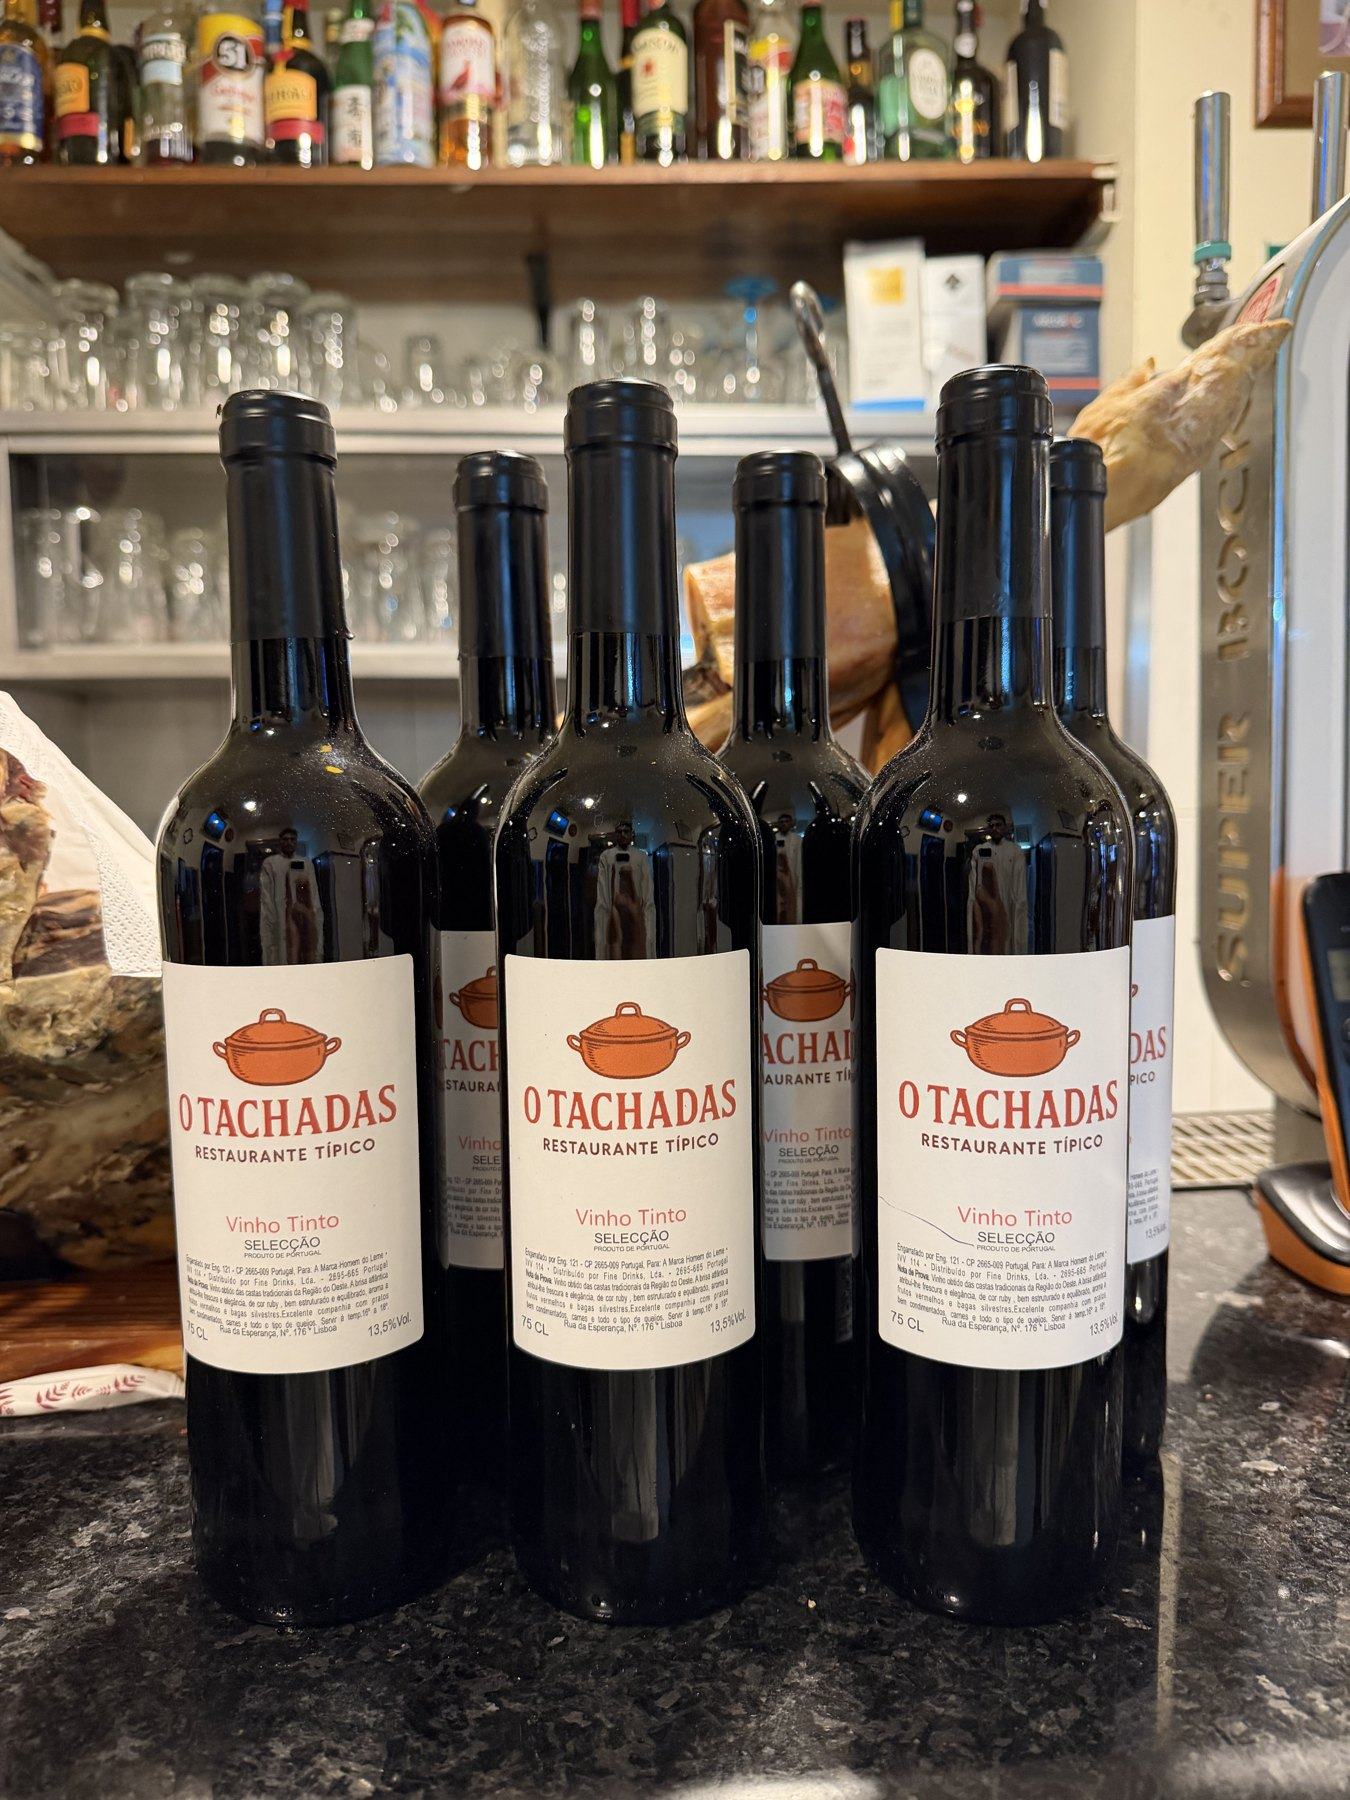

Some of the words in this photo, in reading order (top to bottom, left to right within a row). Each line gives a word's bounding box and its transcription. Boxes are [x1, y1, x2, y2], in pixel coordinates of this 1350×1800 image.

[1216, 711, 1252, 989] SUPER
[765, 1072, 831, 1085] AURANTE
[179, 1093, 193, 1131] O
[198, 1084, 397, 1138] TACHADAS
[524, 1085, 541, 1124] O
[547, 1079, 737, 1131] TACHADAS
[898, 1080, 919, 1119] O
[927, 1080, 1118, 1129] TACHADAS
[764, 1128, 809, 1142] Vinho
[815, 1127, 852, 1141] Tinto
[196, 1144, 307, 1163] RESTAURANTE
[315, 1138, 375, 1160] TÍPICO
[543, 1137, 658, 1155] RESTAURANTE
[666, 1132, 719, 1152] TÍPICO
[779, 1144, 839, 1158] SELECÇÃO
[921, 1133, 1046, 1155] RESTAURANTE
[1054, 1134, 1103, 1154] TÍPICO
[575, 1208, 631, 1227] Vinho
[638, 1208, 686, 1226] Tinto
[957, 1205, 1017, 1227] Vinho
[1024, 1209, 1072, 1227] Tinto
[226, 1215, 280, 1234] Vinho
[287, 1214, 339, 1232] Tinto
[244, 1236, 320, 1252] SELECÇÃO
[594, 1230, 669, 1245] SELECÇÃO
[977, 1231, 1055, 1245] SELECÇÃO
[286, 1249, 322, 1258] PORTUGAL
[637, 1243, 670, 1251] PORTUGAL
[370, 1251, 383, 1261] Leme
[585, 1260, 593, 1268] CP
[669, 1257, 684, 1265] Marca
[926, 1252, 934, 1260] por
[950, 1256, 959, 1264] 121
[967, 1258, 975, 1266] CP
[254, 1278, 268, 1286] Fine
[364, 1260, 388, 1274] Portugal
[604, 1272, 617, 1280] Fine
[707, 1257, 728, 1269] Portugal
[971, 1271, 981, 1279] por
[987, 1271, 1001, 1280] Fine
[931, 1274, 946, 1283] Vinho
[976, 1282, 993, 1290] castas
[356, 1299, 367, 1307] com
[577, 1303, 594, 1313] bagas
[665, 1299, 695, 1310] companhia
[957, 1301, 976, 1311] bagas
[522, 1314, 532, 1329] 75
[535, 1321, 549, 1336] CL
[564, 1320, 576, 1329] Rua
[578, 1322, 586, 1330] da
[641, 1323, 654, 1331] 176
[661, 1320, 682, 1329] Lisboa
[891, 1310, 903, 1325] 75
[908, 1317, 924, 1332] CL
[942, 1317, 955, 1326] Rua
[958, 1320, 966, 1328] da
[1044, 1322, 1065, 1331] Lisboa
[187, 1320, 194, 1334] 75
[197, 1326, 208, 1340] CL
[220, 1324, 231, 1333] Rua
[294, 1327, 306, 1336] 176
[314, 1324, 337, 1335] Lisboa
